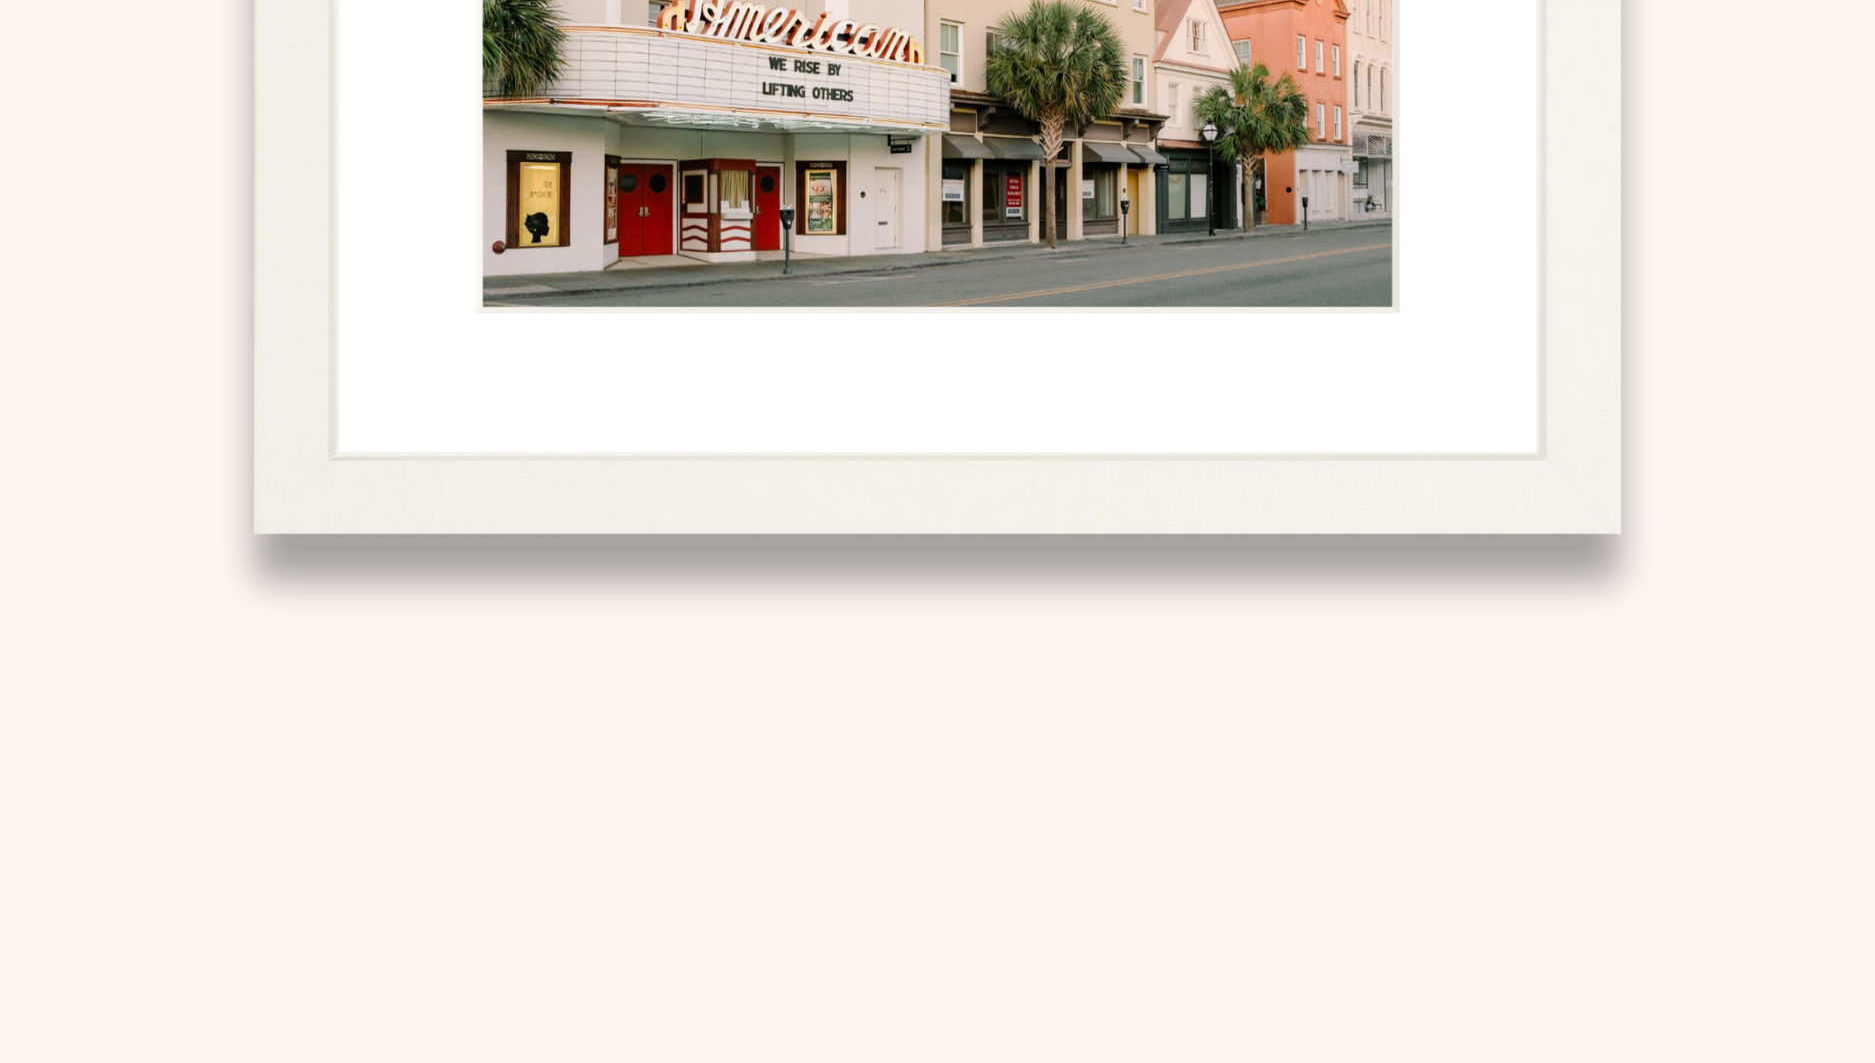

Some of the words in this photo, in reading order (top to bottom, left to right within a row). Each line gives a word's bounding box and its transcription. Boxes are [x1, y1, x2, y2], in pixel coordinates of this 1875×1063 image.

[769, 56, 787, 71] WE
[794, 60, 820, 75] RISE
[828, 63, 841, 76] BY
[762, 81, 806, 98] LIFTING
[812, 87, 854, 102] OTHERS
